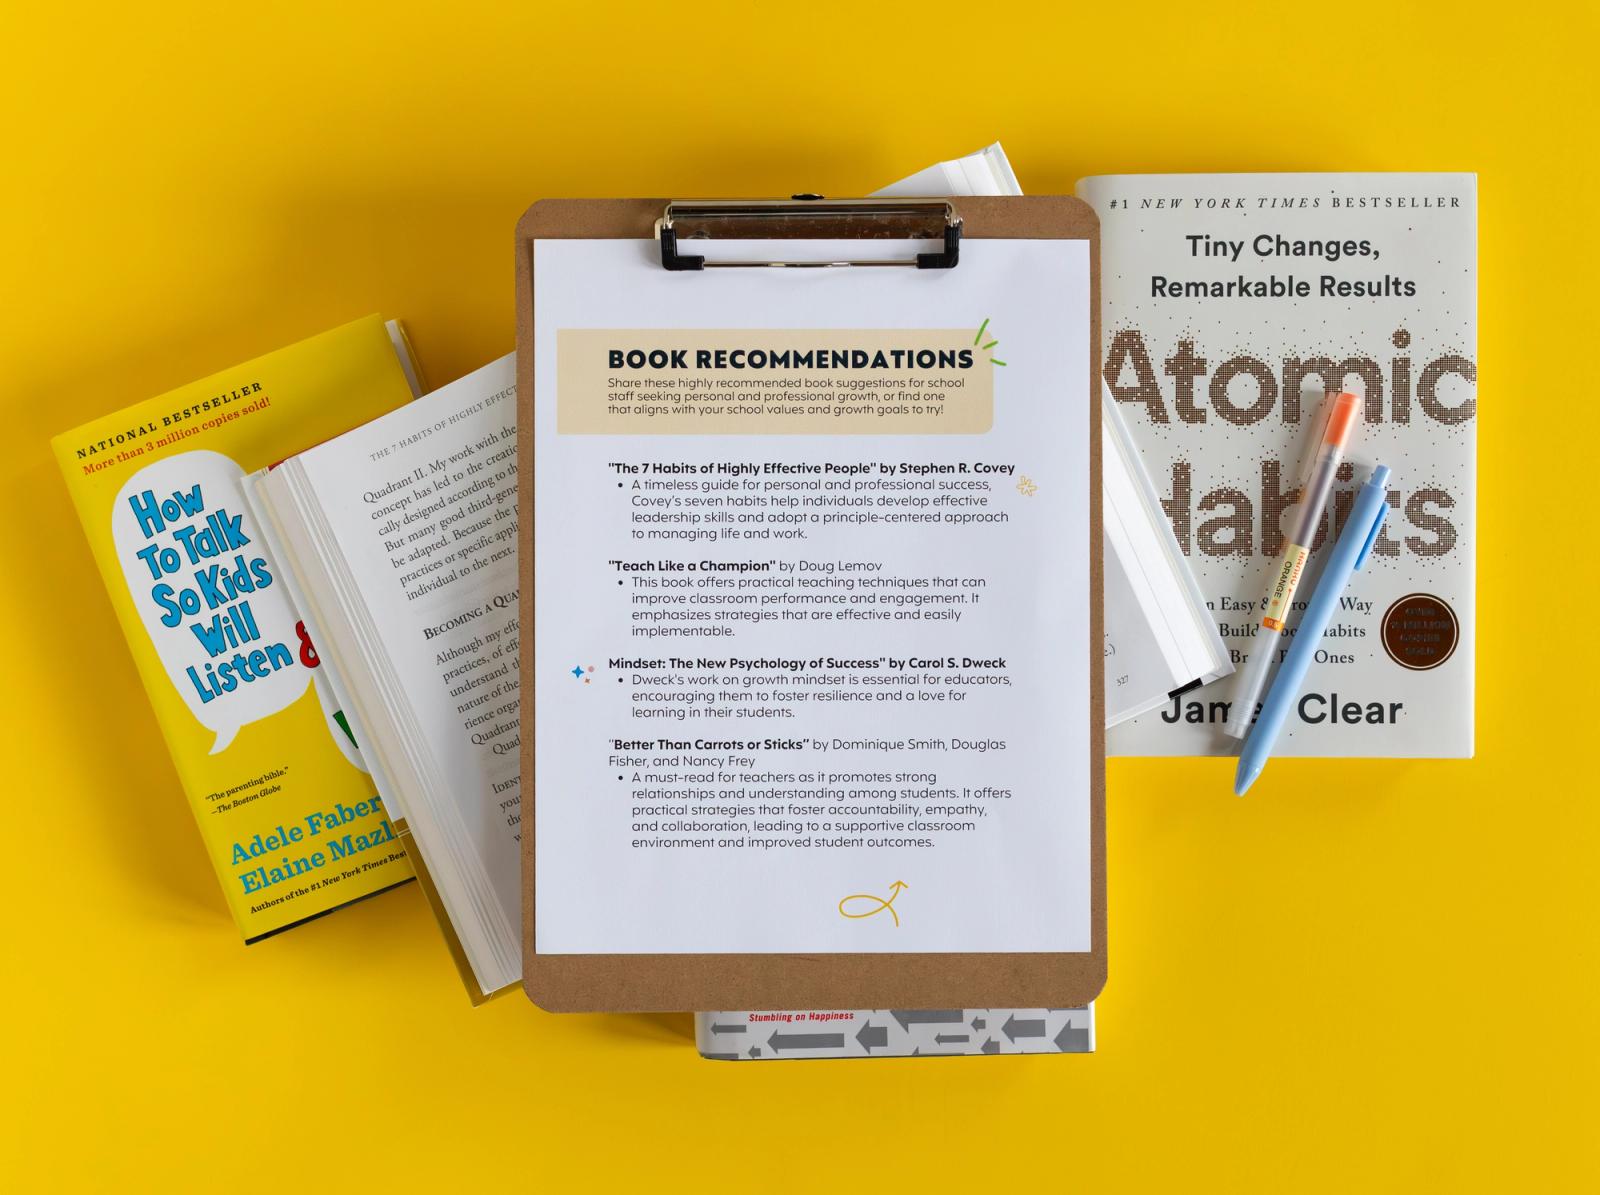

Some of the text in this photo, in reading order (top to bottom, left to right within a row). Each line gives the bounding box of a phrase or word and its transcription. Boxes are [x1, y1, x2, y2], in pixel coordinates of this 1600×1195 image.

[1109, 197, 1461, 210] #1 NEW YORK TIMES BESTSELLER
[1185, 234, 1380, 262] Tiny Changes,
[1151, 275, 1417, 298] Remarkable Results
[608, 349, 974, 370] BOOK RECOMMENDATIONS
[607, 376, 965, 391] Share these highly recommended book suggestions for school
[1102, 328, 1477, 426] Atomic
[607, 388, 946, 404] staff seeking personal and professional growth, or find one
[607, 403, 944, 417] that aligns with your school values and growth goals to try!
[76, 381, 263, 460] NATIONAL BESTSELLER
[369, 384, 519, 463] THE 7 HABITS OF HIGHLY EFFECT
[83, 396, 272, 477] More than 3 million copies sold!
[363, 475, 414, 505] Quadrant
[428, 458, 448, 475] My
[448, 444, 475, 465] work
[475, 432, 500, 453] with
[501, 424, 518, 441] the
[641, 462, 650, 474] 7
[652, 461, 698, 475] Habits
[699, 462, 715, 475] of
[716, 461, 761, 477] Highly
[763, 461, 822, 475] Effective
[879, 462, 897, 477] by
[899, 462, 956, 477] Stephen
[958, 462, 972, 474] R.
[973, 462, 1016, 477] Covey
[128, 484, 205, 539] How
[136, 508, 251, 580] To Talk
[406, 546, 516, 602] individual to the next.
[657, 559, 685, 572] Like
[687, 562, 697, 572] a
[779, 559, 796, 575] by
[799, 559, 835, 575] Doug
[838, 560, 883, 572] Lemov
[1273, 560, 1293, 599] ORANGE
[151, 555, 273, 628] So Kids
[1220, 597, 1256, 615] Easy
[1339, 597, 1373, 615] Way
[190, 600, 261, 658] Will
[422, 602, 494, 641] BECOMING A
[1323, 623, 1366, 637] abits
[608, 656, 667, 671] Mindset:
[668, 657, 694, 670] The
[696, 657, 728, 671] New
[729, 657, 807, 672] Psychology
[808, 656, 825, 669] of
[888, 656, 906, 672] by
[908, 656, 945, 669] Carol
[946, 657, 960, 669] S.
[962, 656, 1007, 669] Dweck
[1314, 650, 1355, 664] Ones
[186, 642, 294, 704] Listen
[1298, 693, 1404, 724] Clear
[656, 738, 692, 751] Than
[694, 738, 745, 751] Carrots
[746, 741, 762, 751] or
[812, 738, 830, 753] by
[832, 738, 905, 753] Dominique
[907, 738, 948, 752] Smith,
[951, 738, 1007, 753] Douglas
[608, 754, 756, 770] Fisher, and Nancy Frey
[226, 775, 265, 797] parenting
[232, 793, 260, 809] Boston
[259, 784, 282, 798] Globe
[231, 796, 383, 866] Adele Faber
[238, 820, 399, 895] Elaine Mazl
[250, 896, 285, 915] Authors
[285, 889, 295, 901] of
[294, 884, 310, 897] the
[310, 880, 322, 892] #1
[322, 875, 341, 888] New
[340, 867, 362, 883] York
[361, 857, 389, 873] Times
[749, 1012, 854, 1023] Stumbling on Happiness
